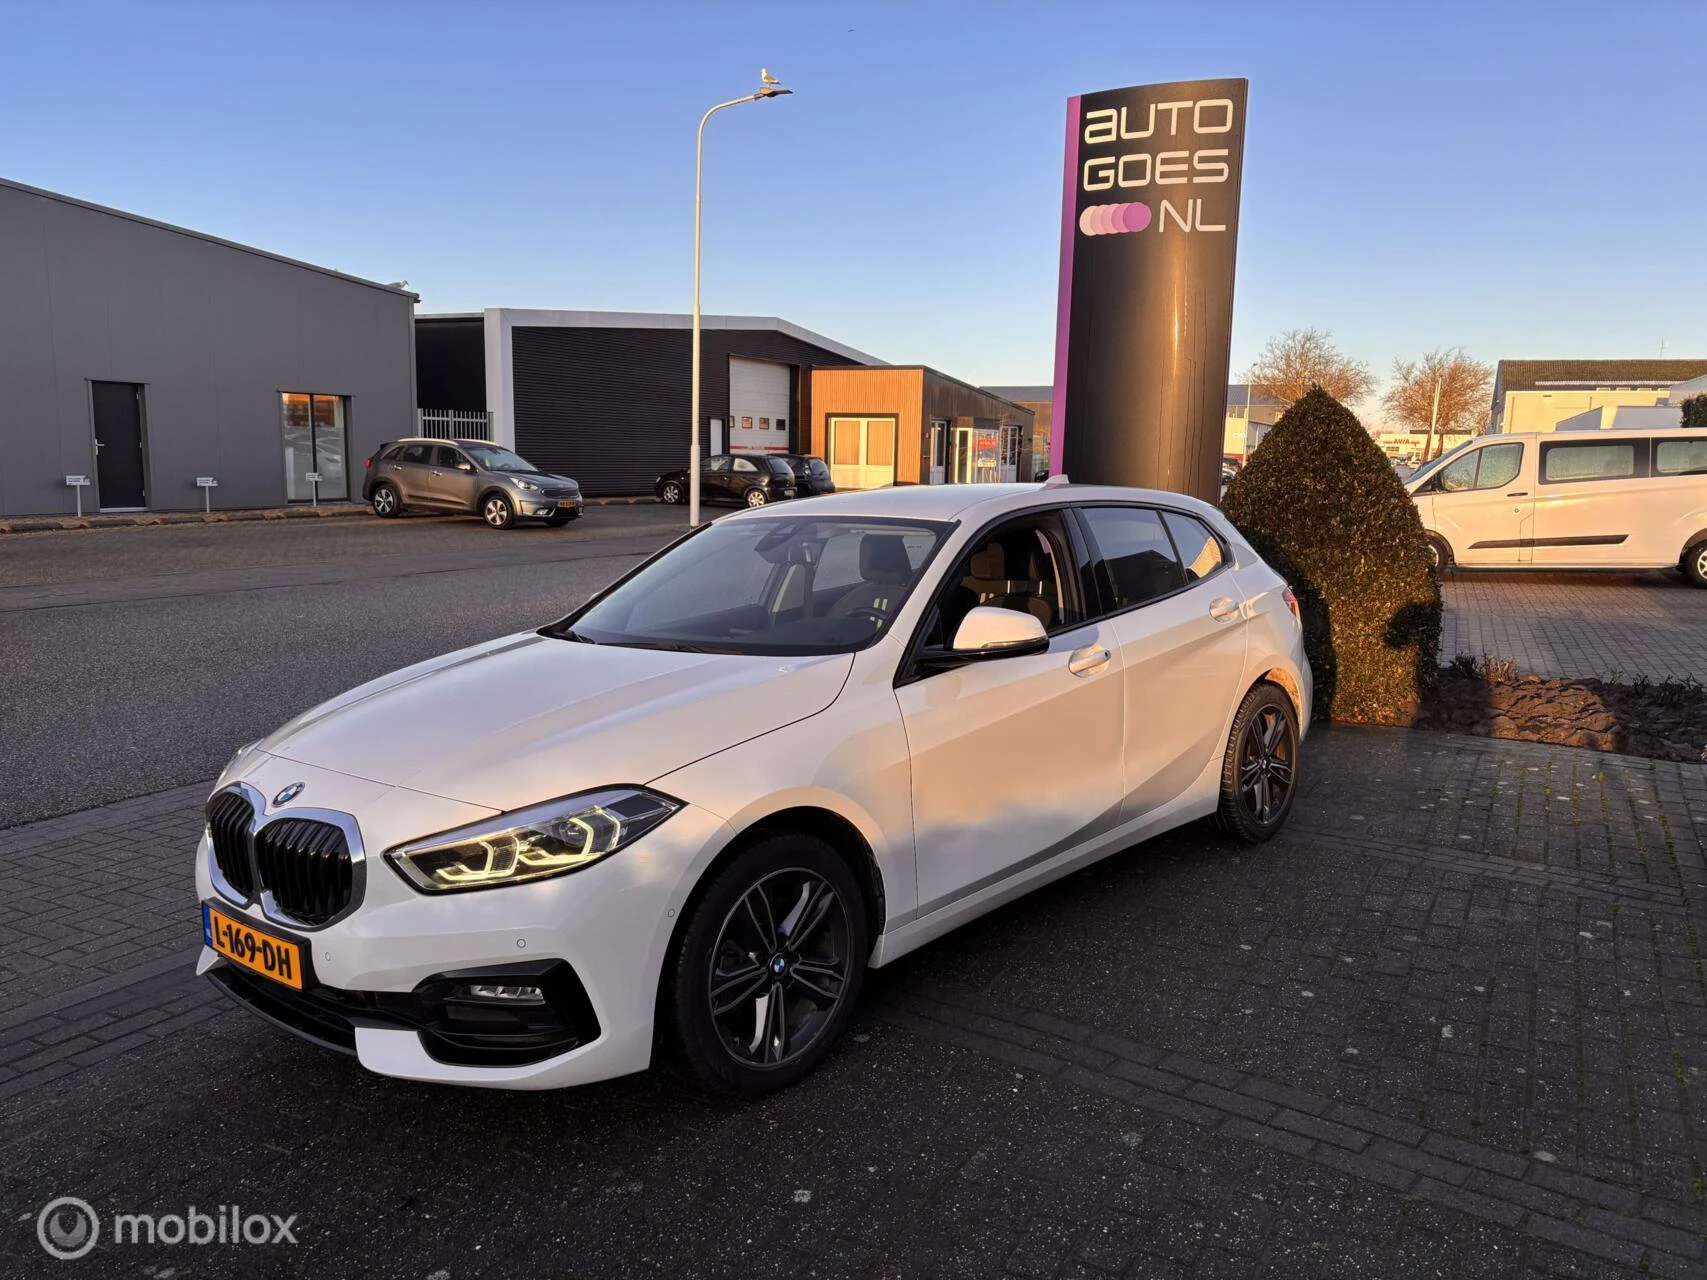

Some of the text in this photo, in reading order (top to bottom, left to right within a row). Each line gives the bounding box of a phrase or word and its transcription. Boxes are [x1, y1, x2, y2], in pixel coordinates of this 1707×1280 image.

[1083, 149, 1229, 192] GOES
[1159, 198, 1226, 233] NL
[214, 916, 292, 980] L-169-DH
